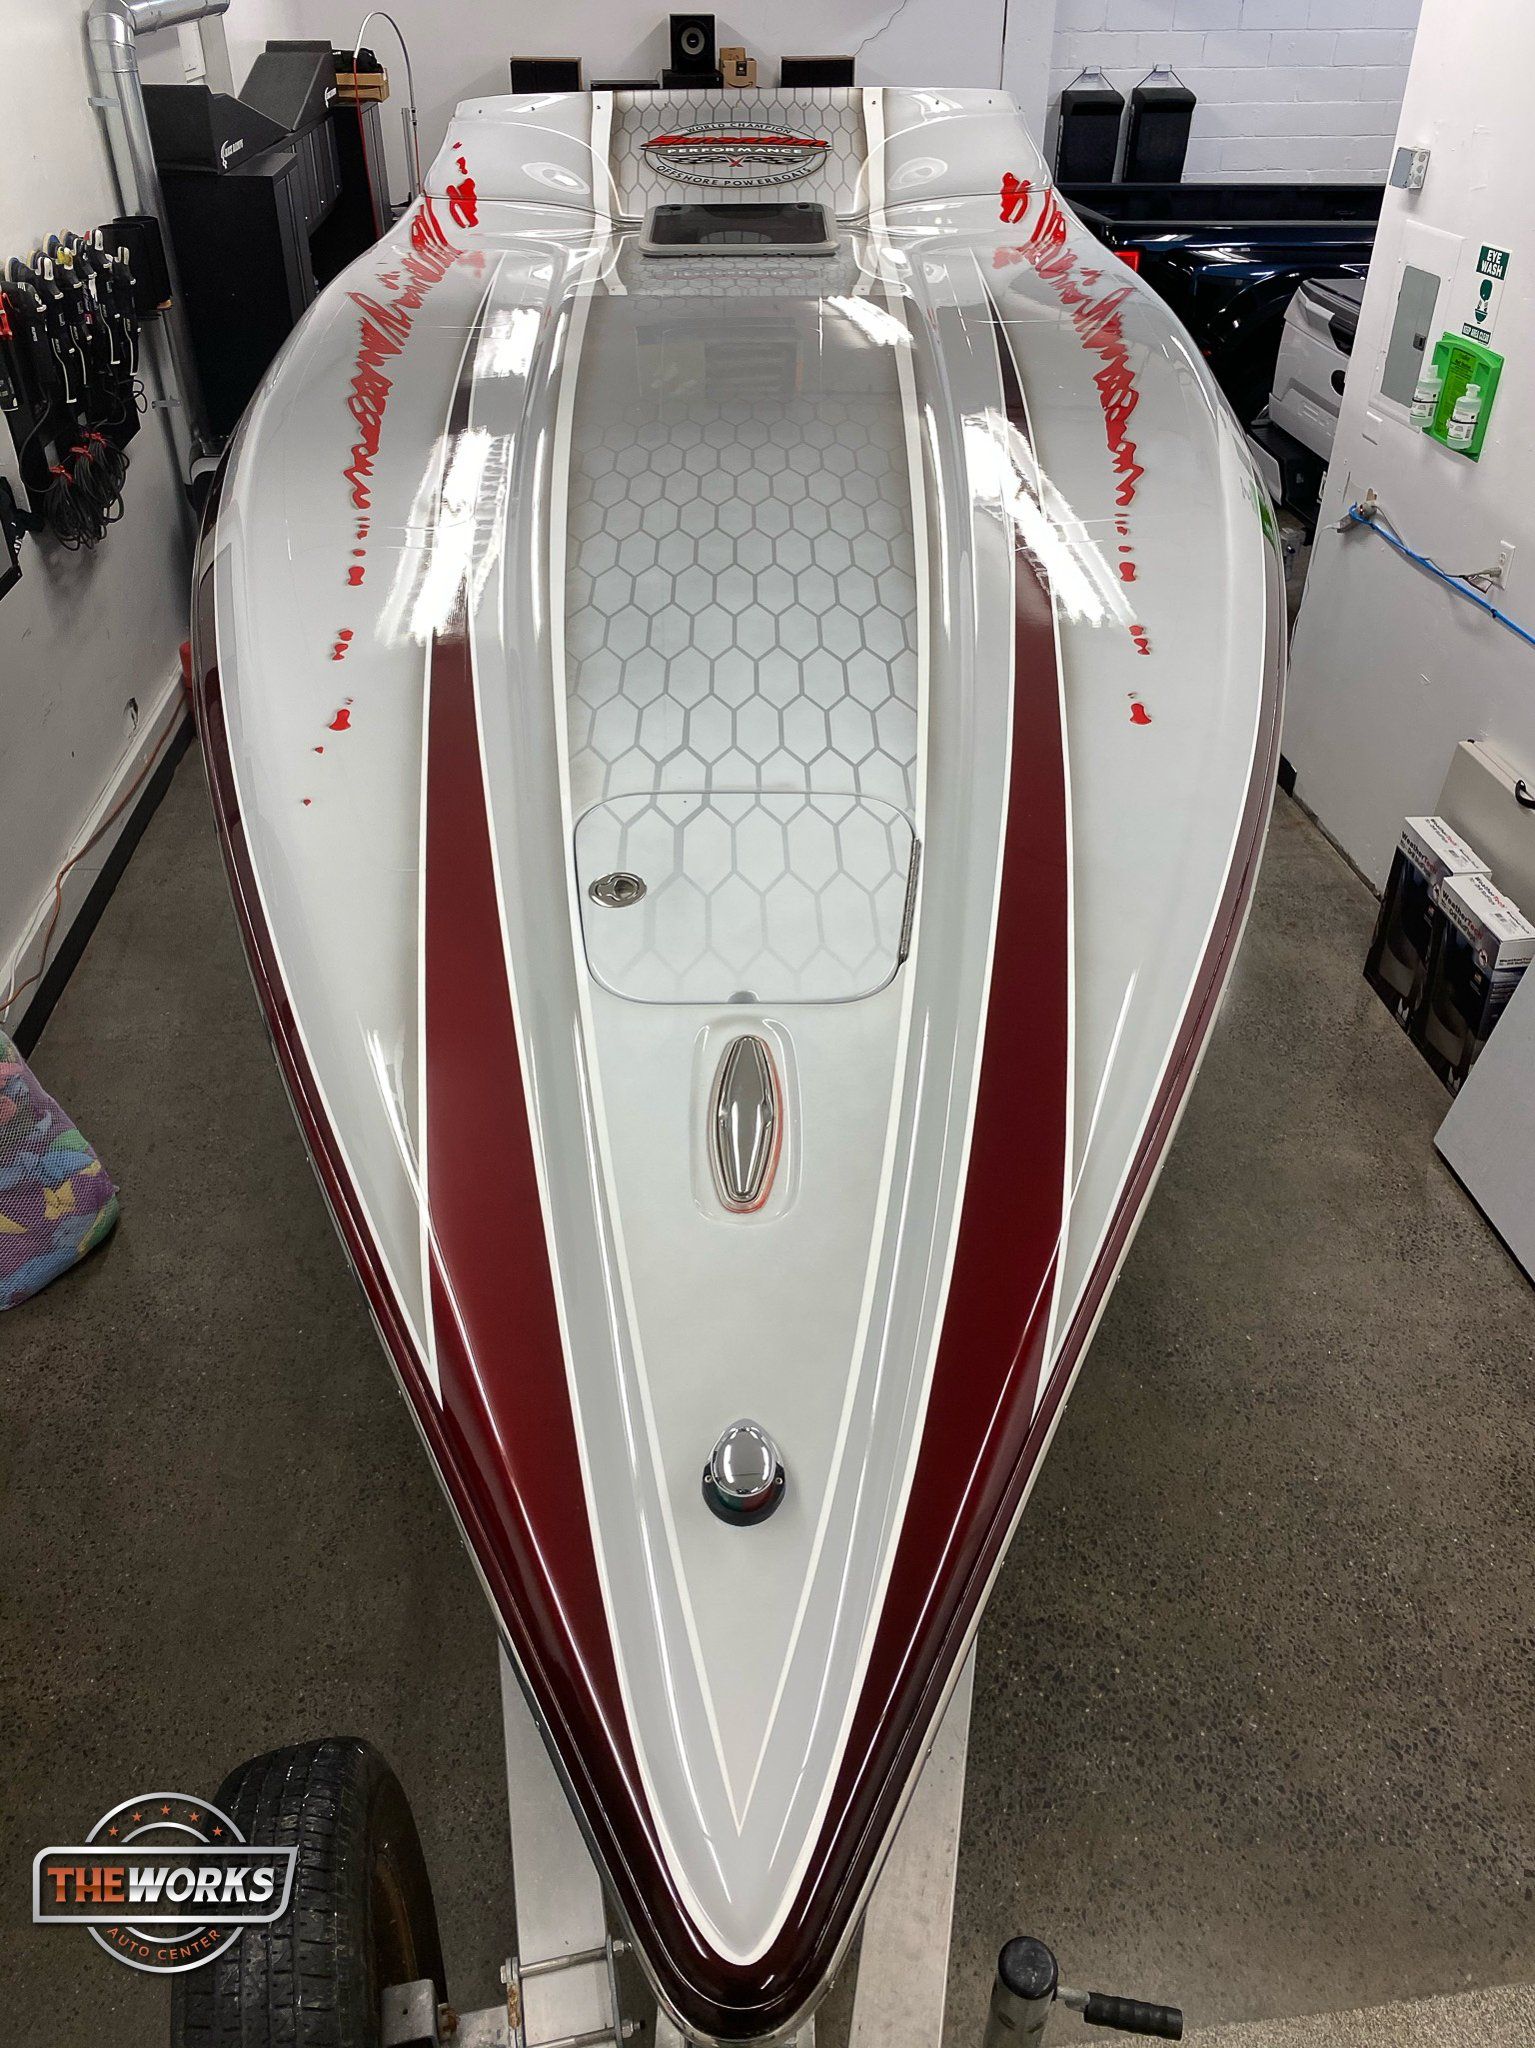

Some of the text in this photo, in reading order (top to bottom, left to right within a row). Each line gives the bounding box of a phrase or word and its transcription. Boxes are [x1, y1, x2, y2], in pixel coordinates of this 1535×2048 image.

[687, 122, 792, 134] WORLD CHAMPION
[656, 165, 812, 187] OFFSHORE POWERBOATS
[1486, 249, 1503, 265] EYE
[1481, 259, 1504, 278] WASH
